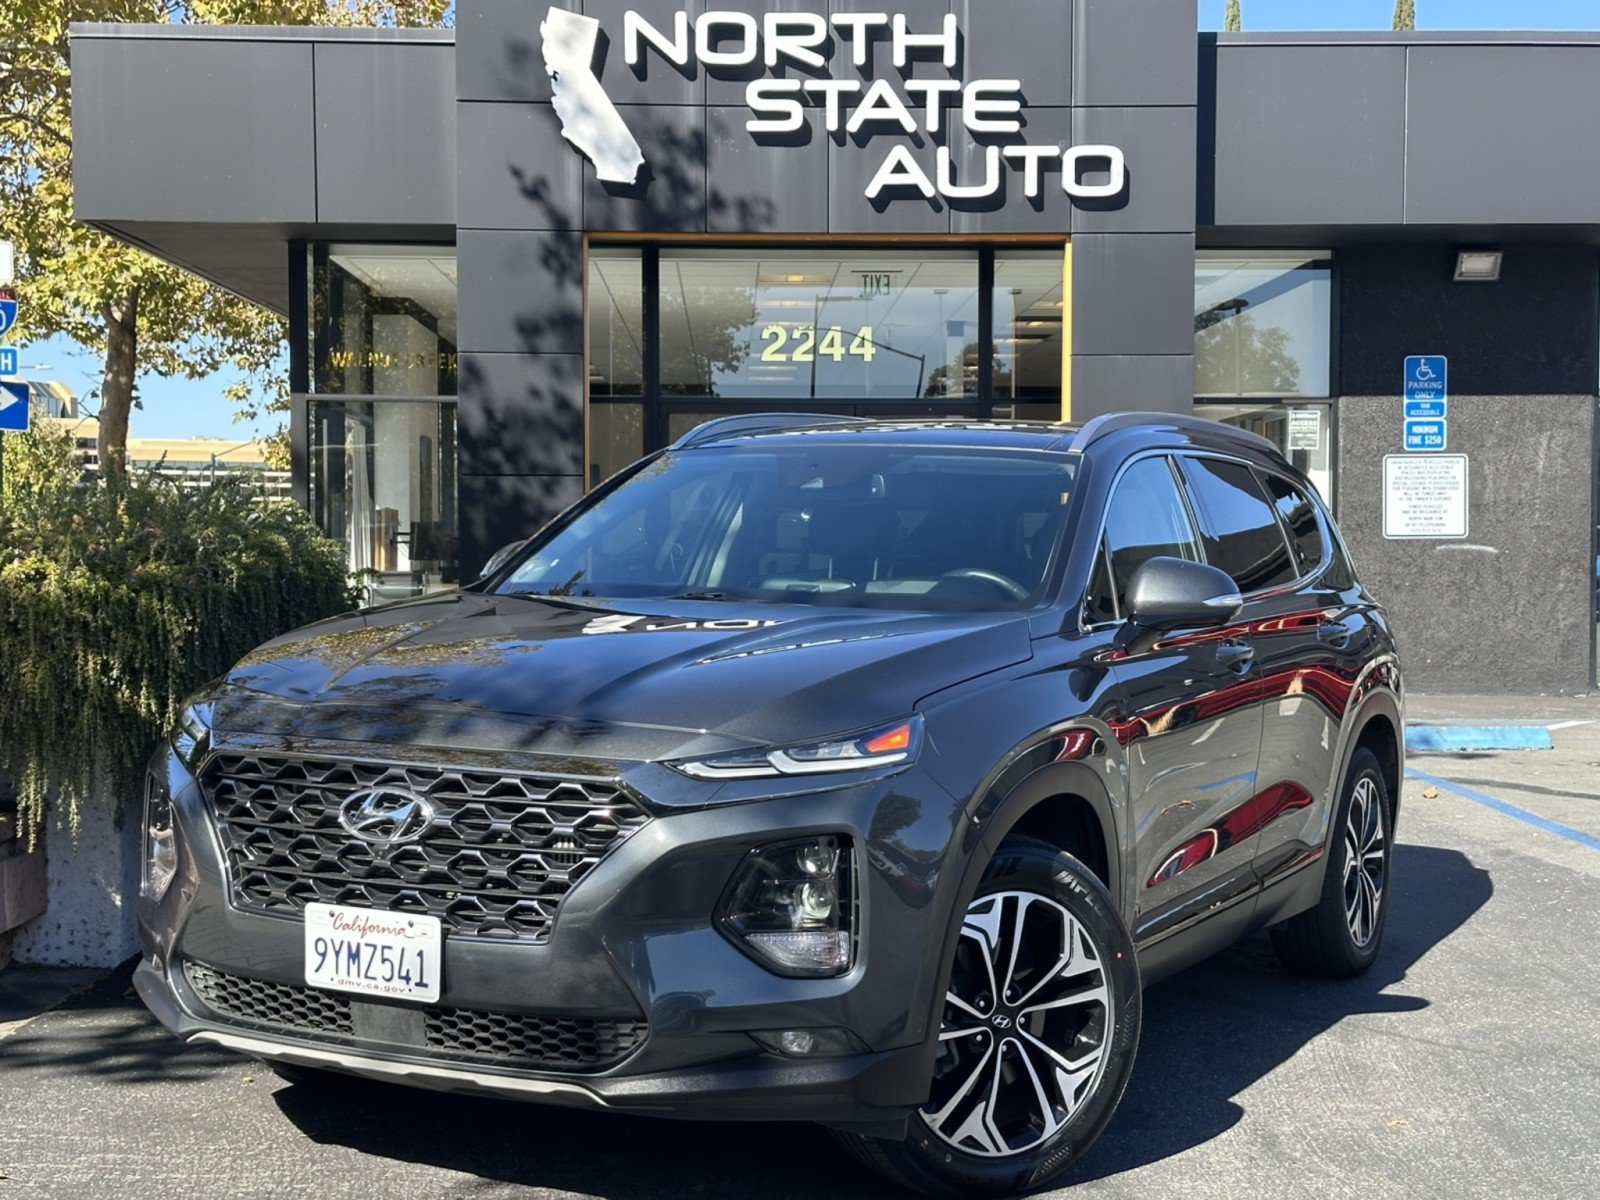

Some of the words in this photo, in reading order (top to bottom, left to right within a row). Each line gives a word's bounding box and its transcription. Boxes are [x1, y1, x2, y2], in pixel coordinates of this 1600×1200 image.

[624, 10, 957, 67] NORTH
[745, 78, 1021, 133] STATE
[864, 144, 1124, 198] AUTO
[761, 324, 876, 362] 2244
[1408, 381, 1442, 389] PARKING
[1415, 391, 1435, 399] ONLY
[1408, 435, 1422, 444] FINE
[1424, 435, 1442, 444] $250
[1412, 425, 1438, 433] MINIMUM
[333, 912, 415, 939] California
[314, 937, 429, 989] 9YMZ541
[338, 979, 405, 993] dmv.ca.gov
